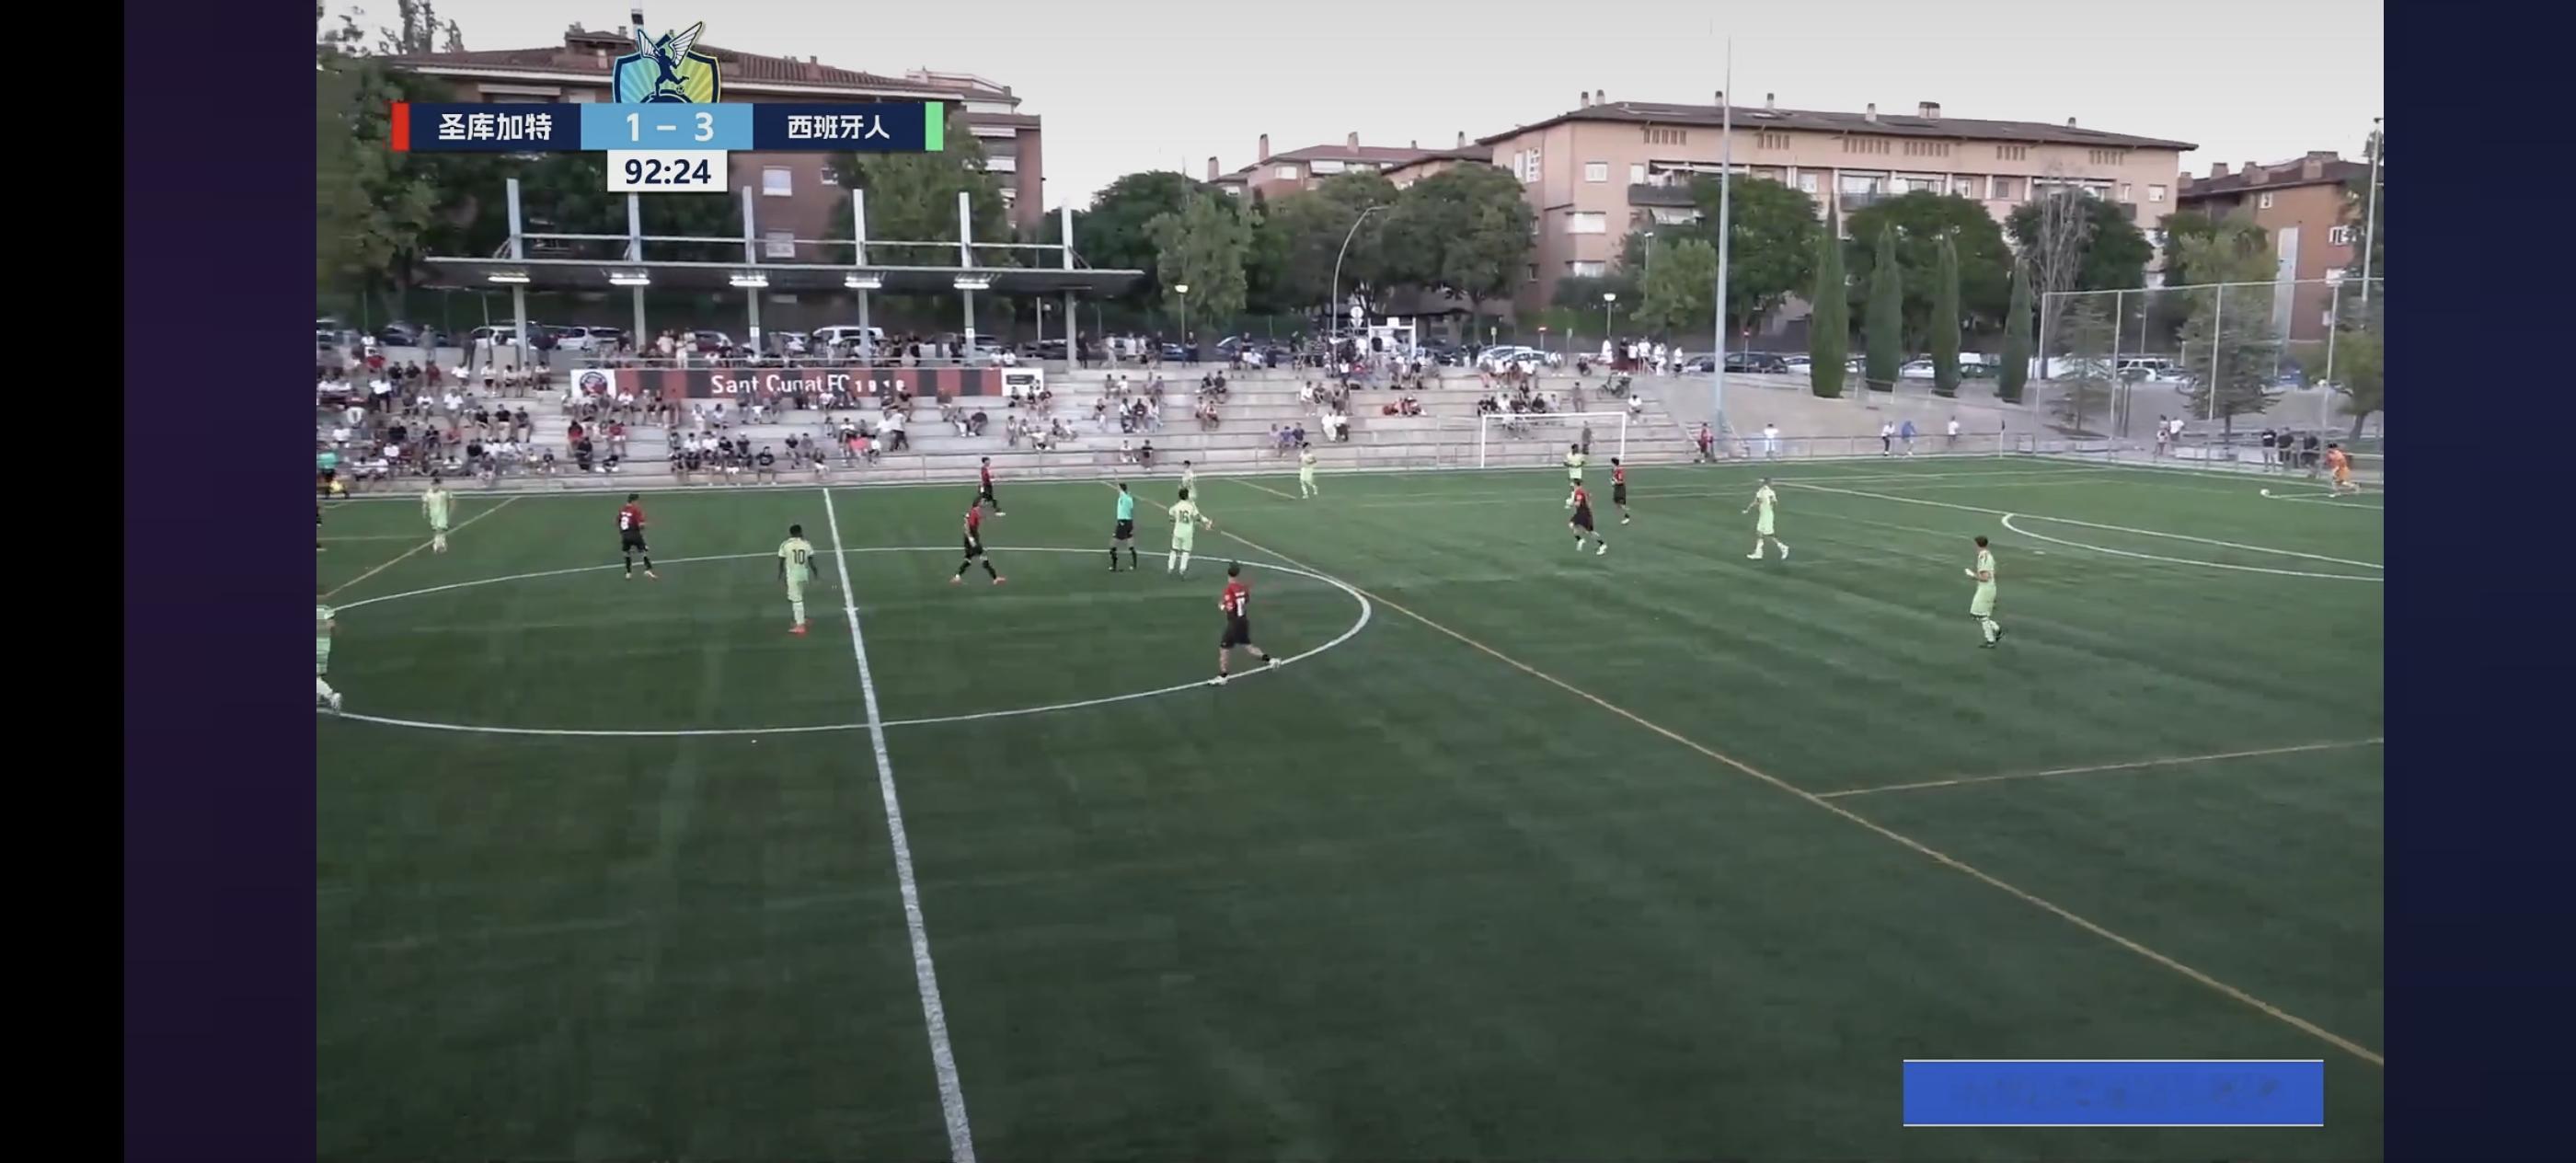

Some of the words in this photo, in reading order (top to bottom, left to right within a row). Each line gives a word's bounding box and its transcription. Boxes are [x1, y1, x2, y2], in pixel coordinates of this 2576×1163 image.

[711, 374, 759, 394] Sant
[827, 374, 850, 393] FC
[792, 548, 806, 565] 10
